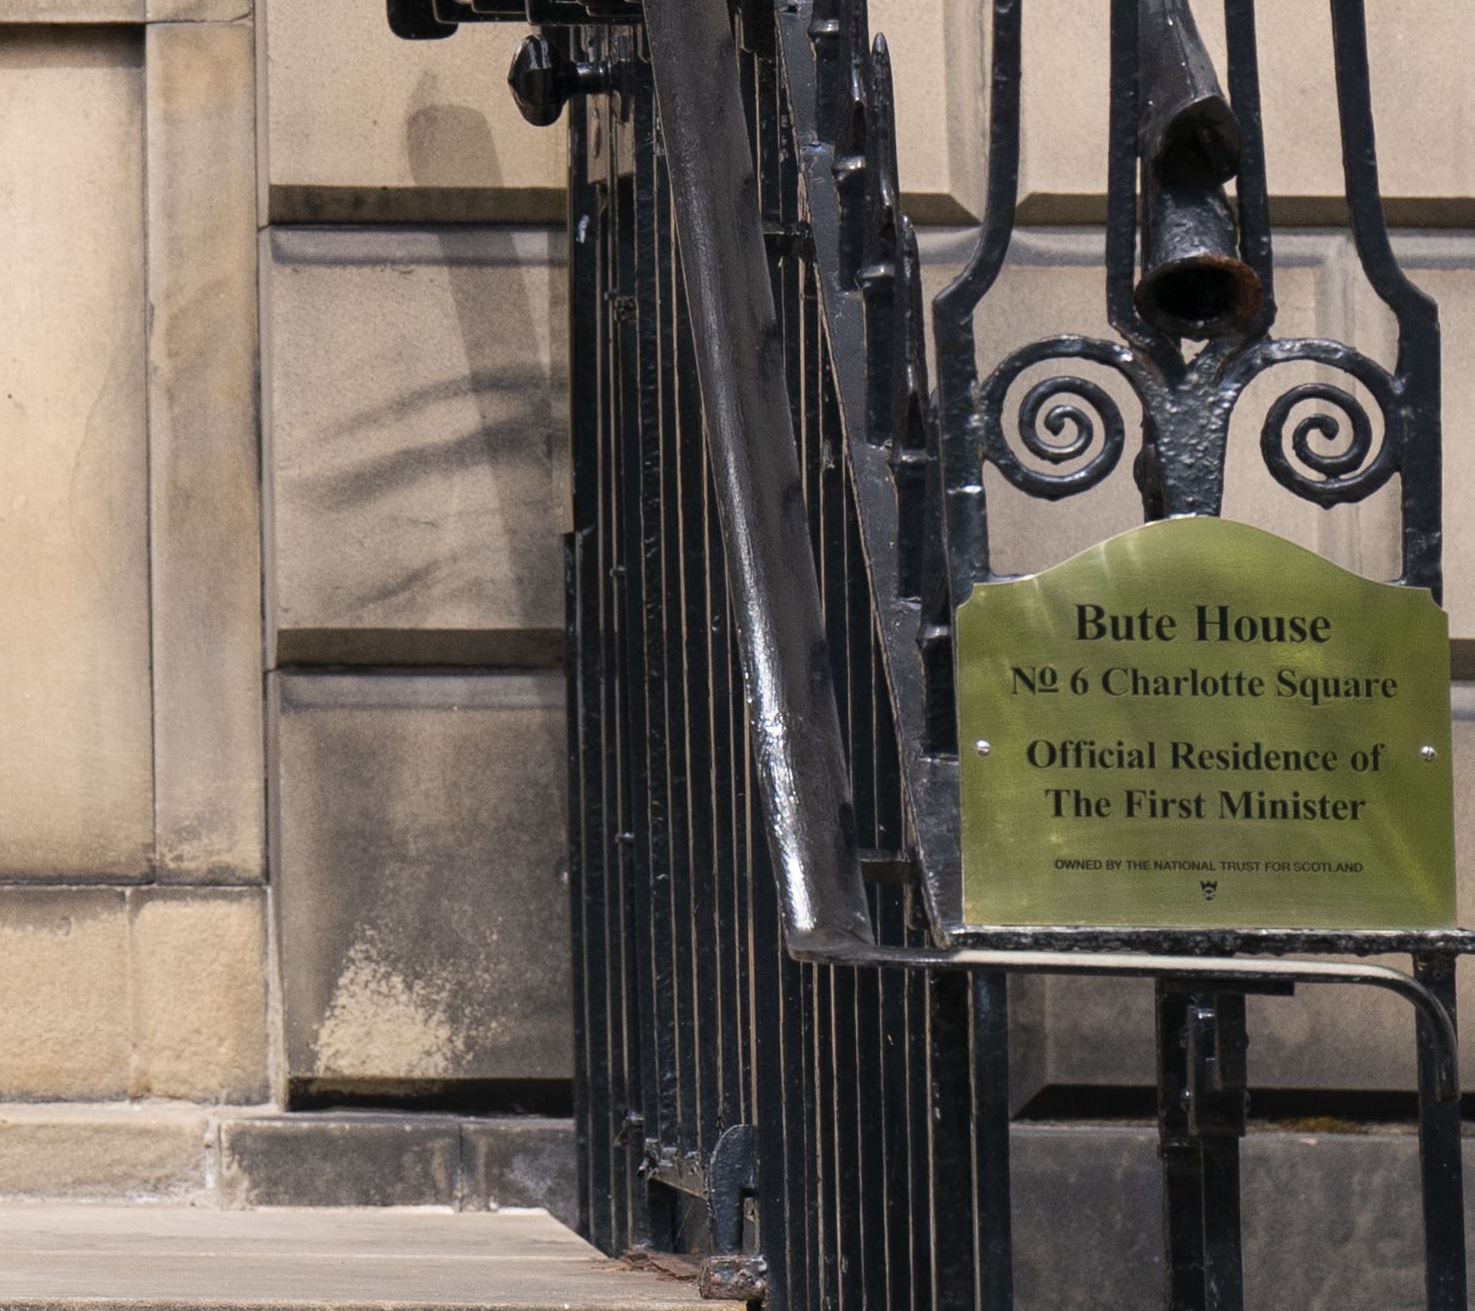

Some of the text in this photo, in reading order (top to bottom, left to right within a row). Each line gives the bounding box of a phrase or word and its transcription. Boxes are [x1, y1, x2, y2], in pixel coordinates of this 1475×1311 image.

[1077, 605, 1331, 643] Bute House
[1070, 669, 1089, 695] 6
[1102, 668, 1264, 697] Charlotte
[1277, 670, 1397, 705] Square
[1027, 740, 1385, 772] Official Residence of
[1045, 789, 1366, 820] The First Minister
[1053, 858, 1364, 874] OWNED BY THE NATIONAL TRUST FOR SCOTLAND
